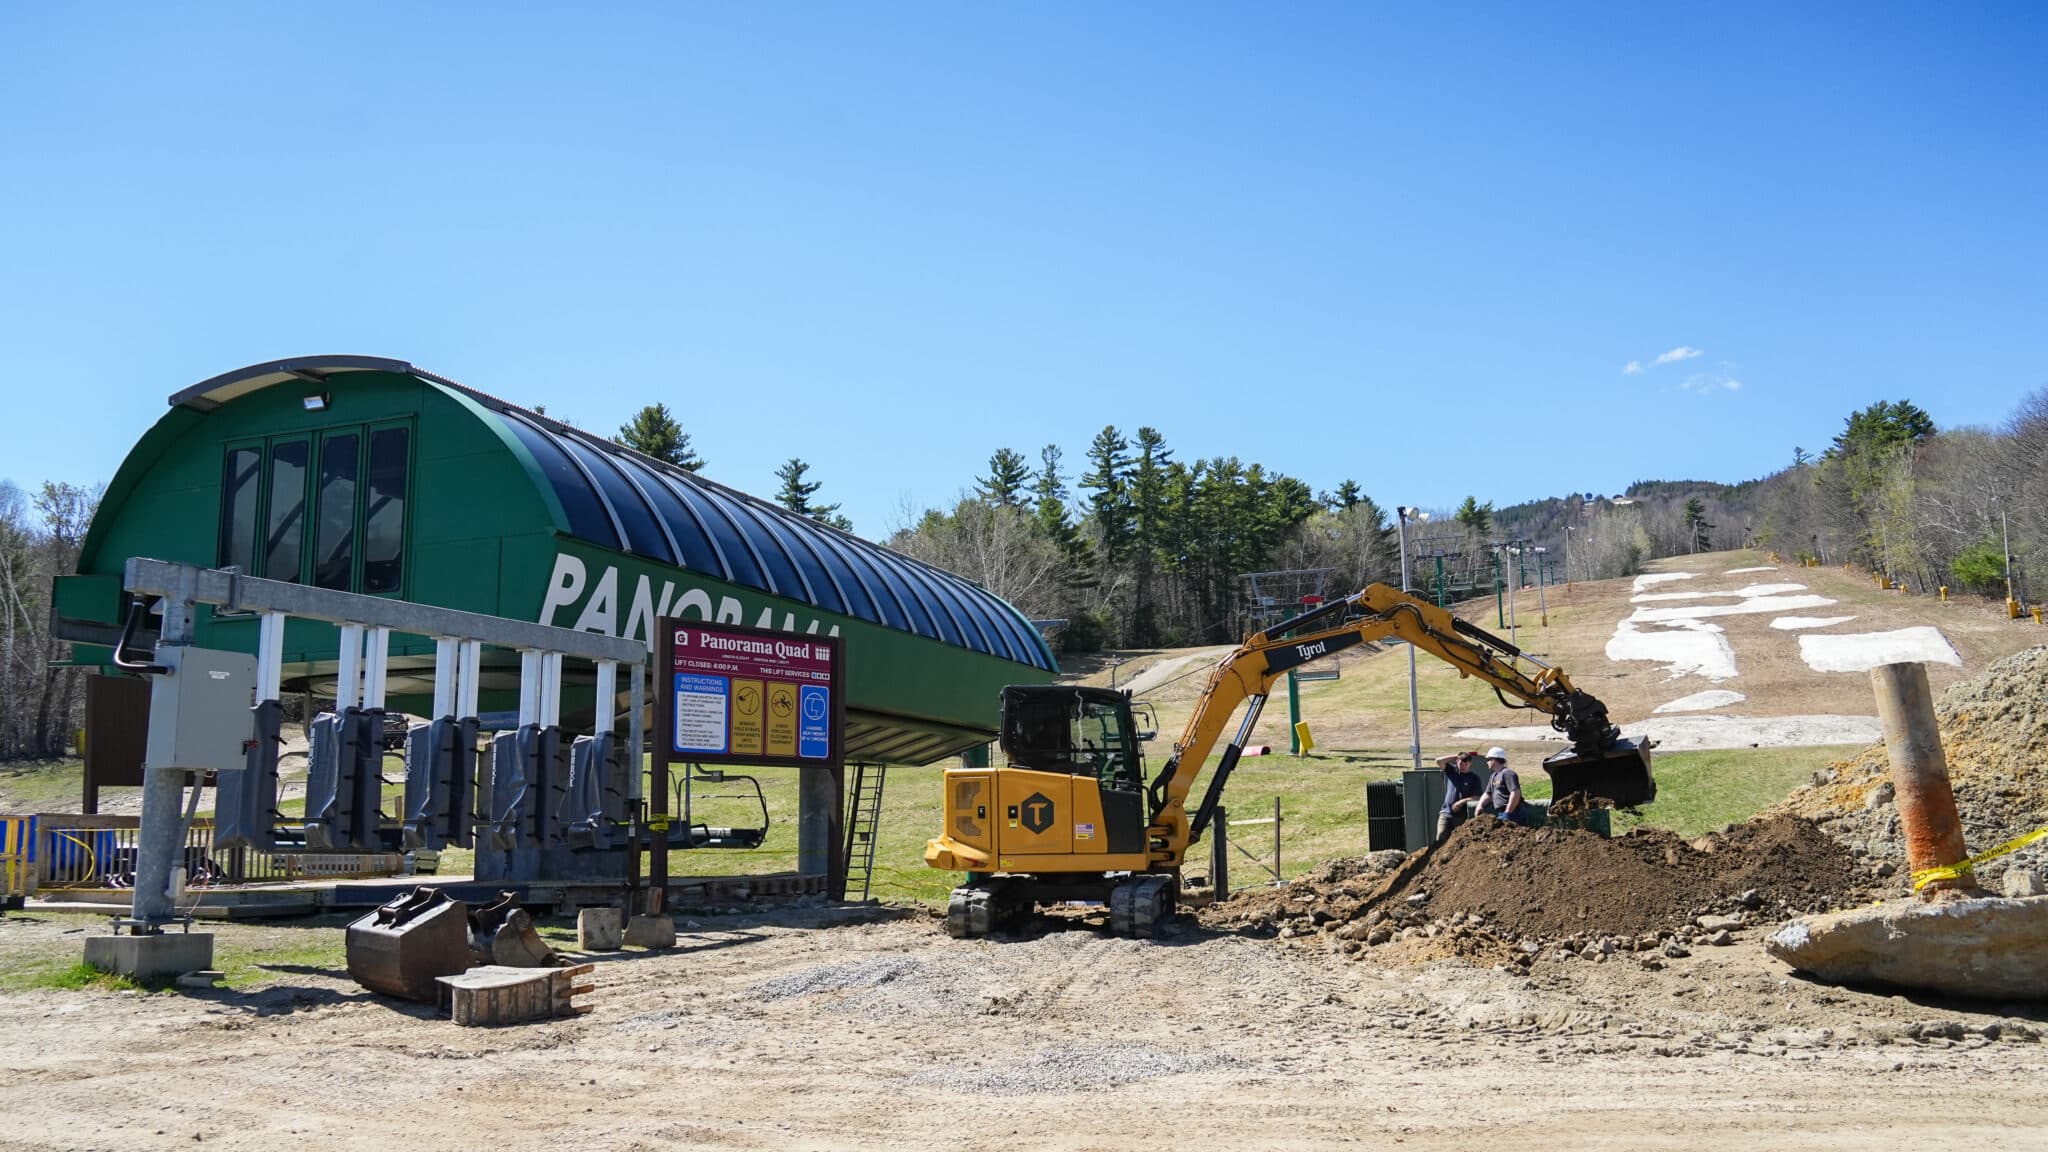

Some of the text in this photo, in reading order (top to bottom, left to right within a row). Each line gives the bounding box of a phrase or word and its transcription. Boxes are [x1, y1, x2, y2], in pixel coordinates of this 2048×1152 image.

[700, 633, 810, 660] Panorama Quad
[1295, 640, 1326, 660] Tyrol
[688, 660, 713, 669] CLOSES:
[713, 662, 727, 670] 4:00
[760, 667, 772, 675] THIS
[681, 677, 723, 686] INSTRUCTIONS
[694, 685, 724, 693] WARNINGS
